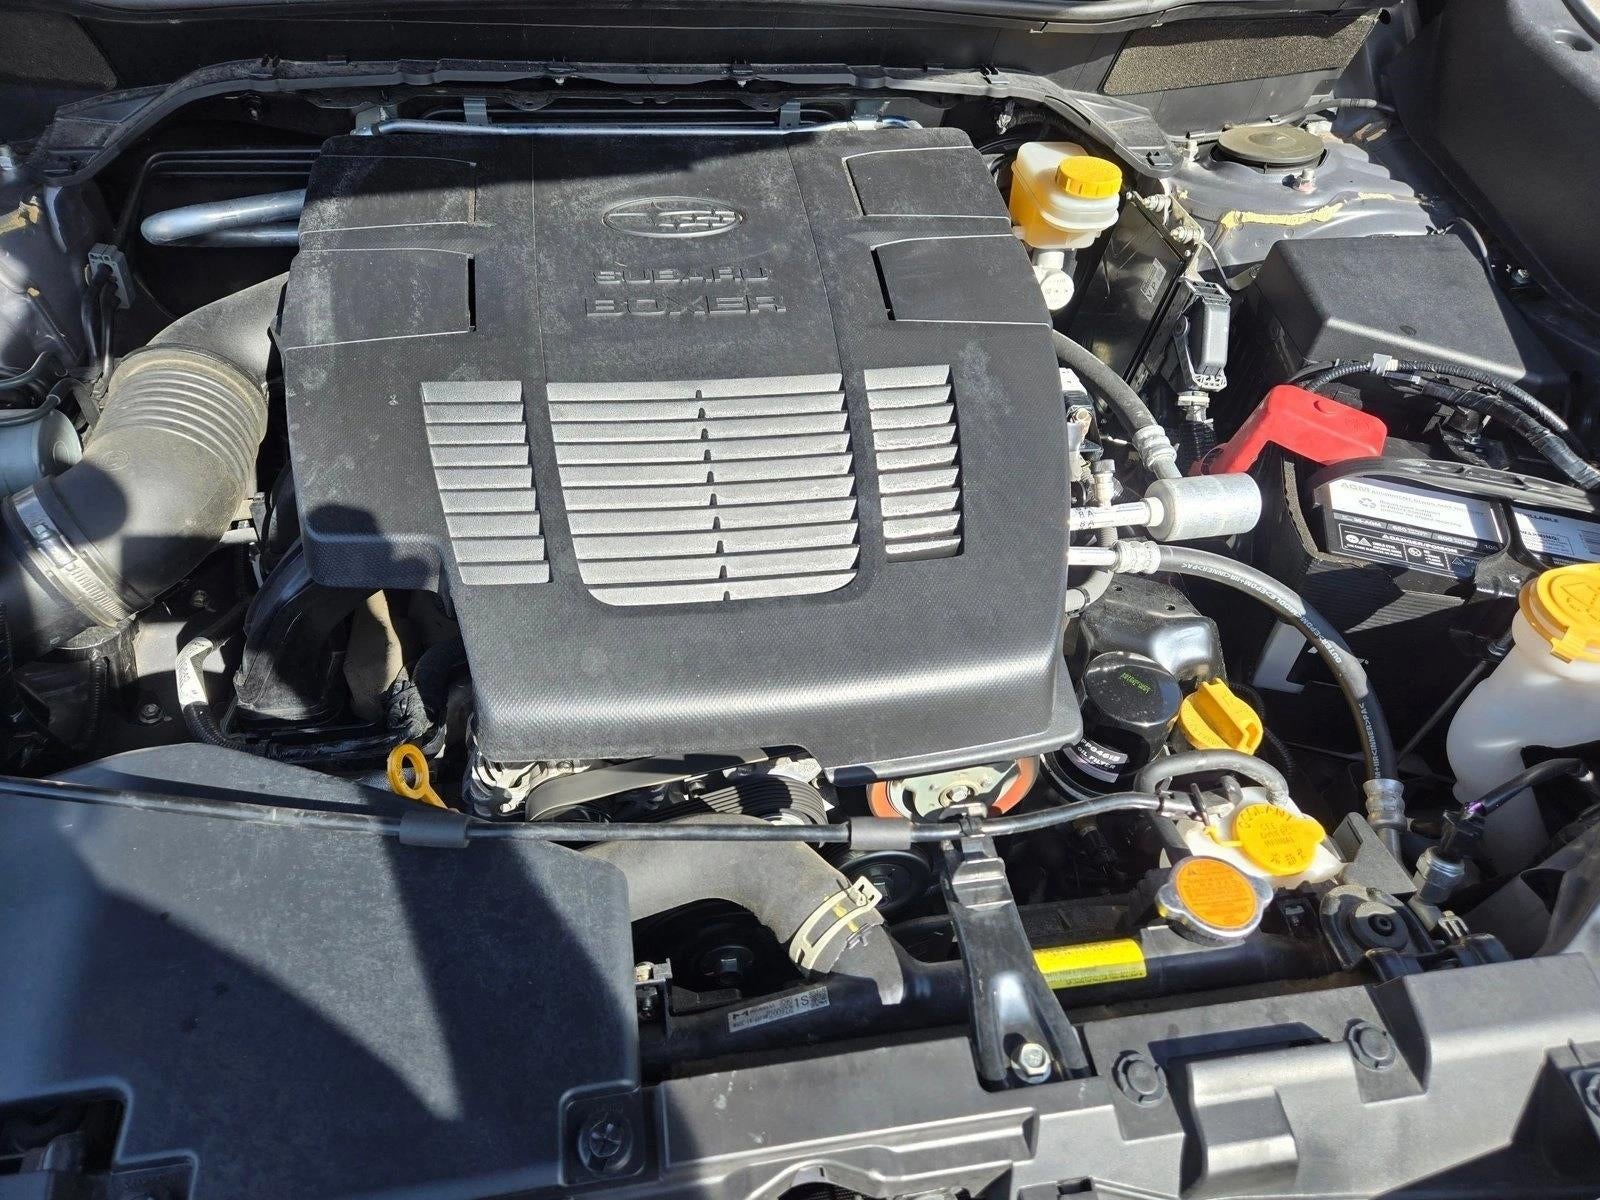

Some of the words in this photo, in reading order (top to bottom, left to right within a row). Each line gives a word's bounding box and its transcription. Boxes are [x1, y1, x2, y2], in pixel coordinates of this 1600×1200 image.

[592, 267, 769, 285] SUBARU
[584, 295, 787, 317] BOXER
[1088, 755, 1117, 770] FILTER
